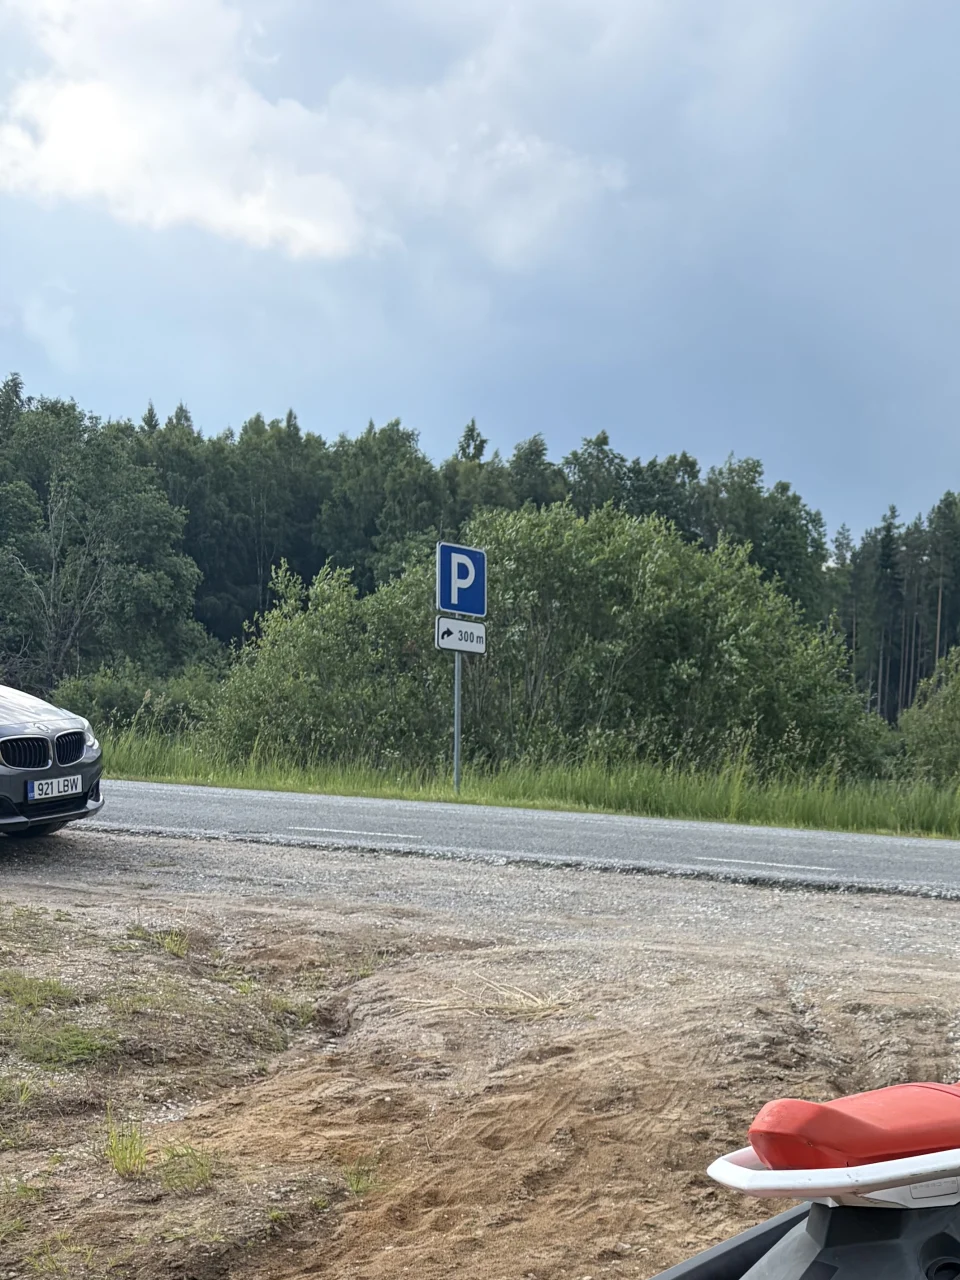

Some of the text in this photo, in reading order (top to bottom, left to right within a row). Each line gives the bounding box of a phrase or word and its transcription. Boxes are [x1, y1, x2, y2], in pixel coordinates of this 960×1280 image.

[451, 552, 475, 604] P
[458, 630, 484, 644] 300 m
[38, 781, 54, 796] 921
[57, 777, 79, 793] LBW
